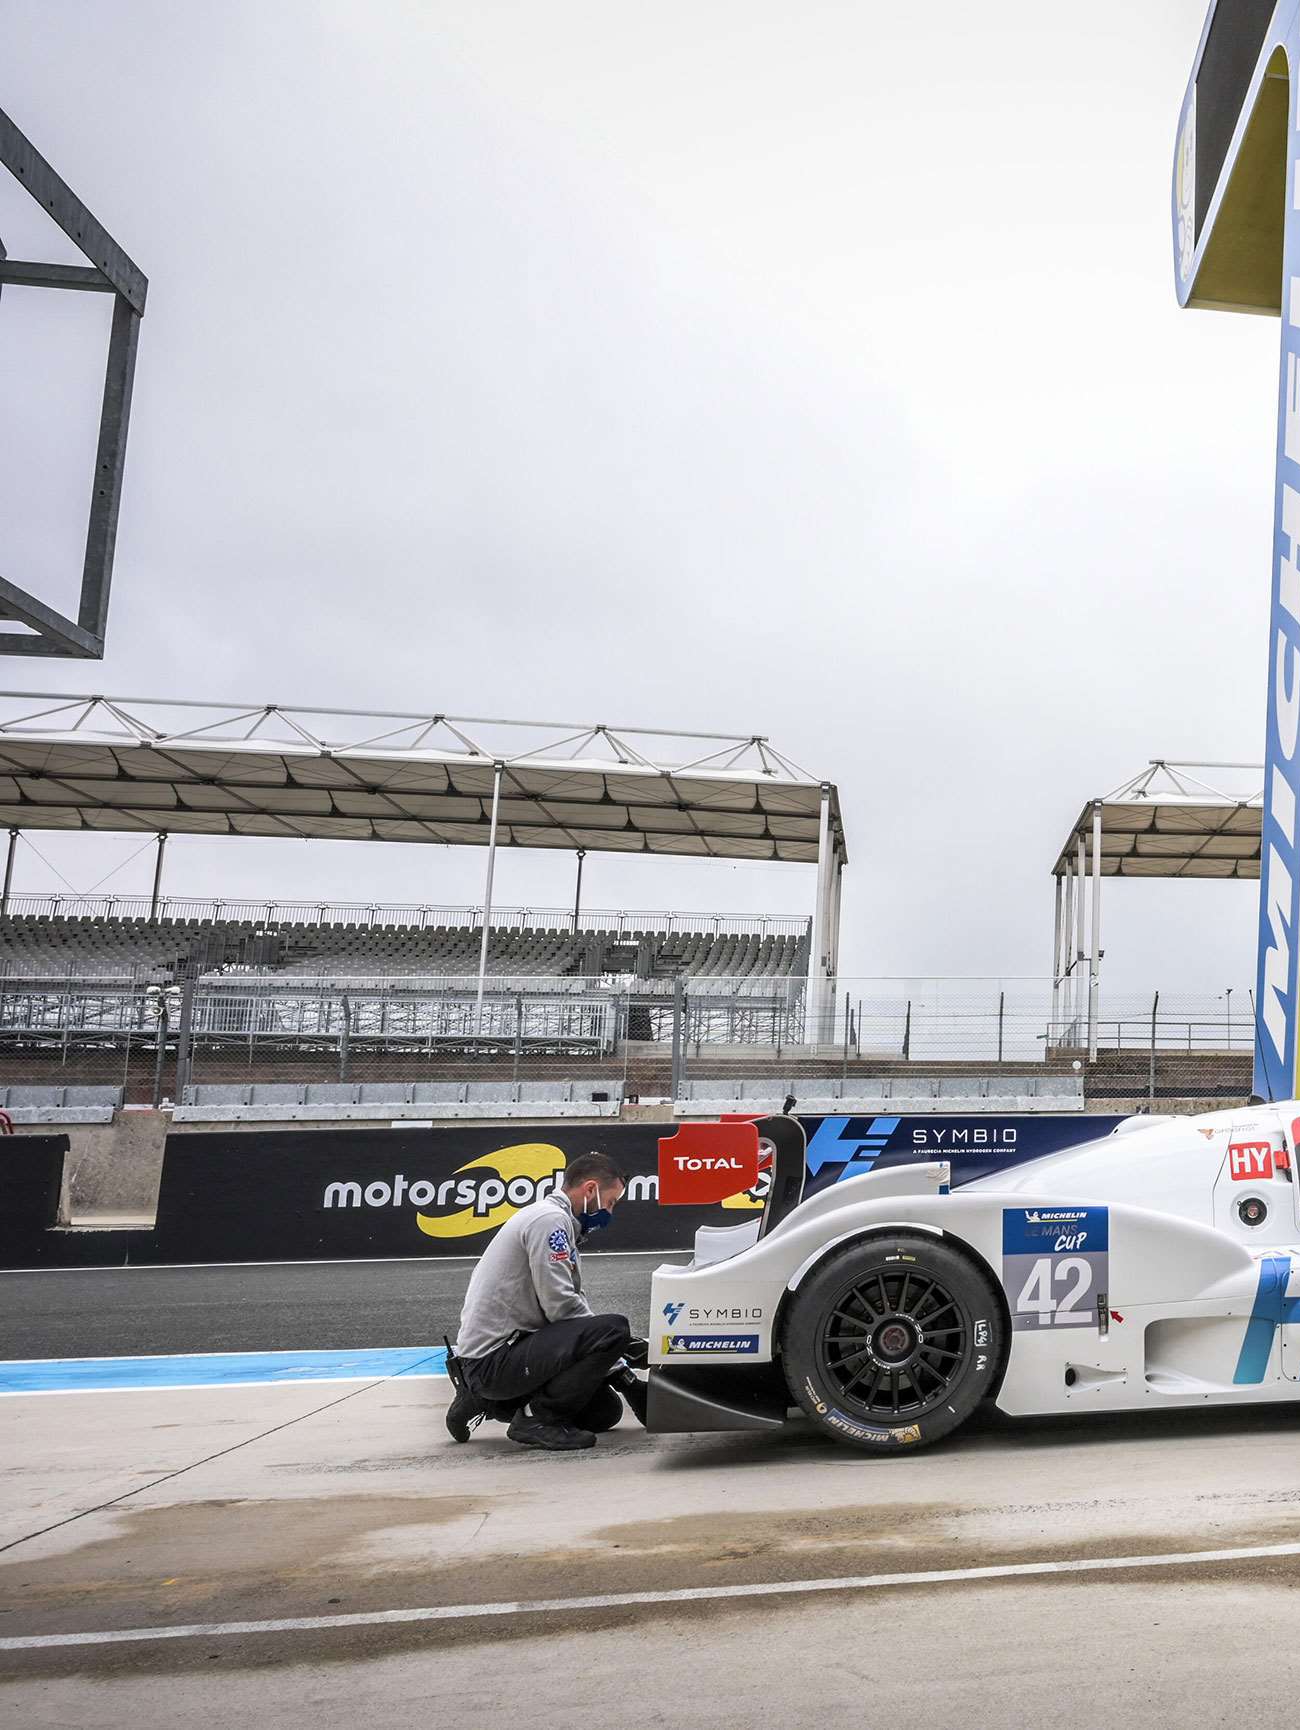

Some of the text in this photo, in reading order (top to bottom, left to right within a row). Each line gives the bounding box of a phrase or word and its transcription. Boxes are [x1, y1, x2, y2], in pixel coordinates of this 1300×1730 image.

[912, 1128, 1017, 1143] SYMBIO
[673, 1156, 744, 1171] TOTAL
[1231, 1147, 1269, 1174] HY
[1041, 1211, 1088, 1220] MICHELIN
[1041, 1224, 1079, 1237] MANS
[1054, 1231, 1088, 1252] CUP
[1016, 1257, 1093, 1325] 42
[689, 1307, 763, 1319] SYMBIO
[688, 1340, 752, 1349] MICHELIN
[827, 1415, 891, 1442] MICHELIN
